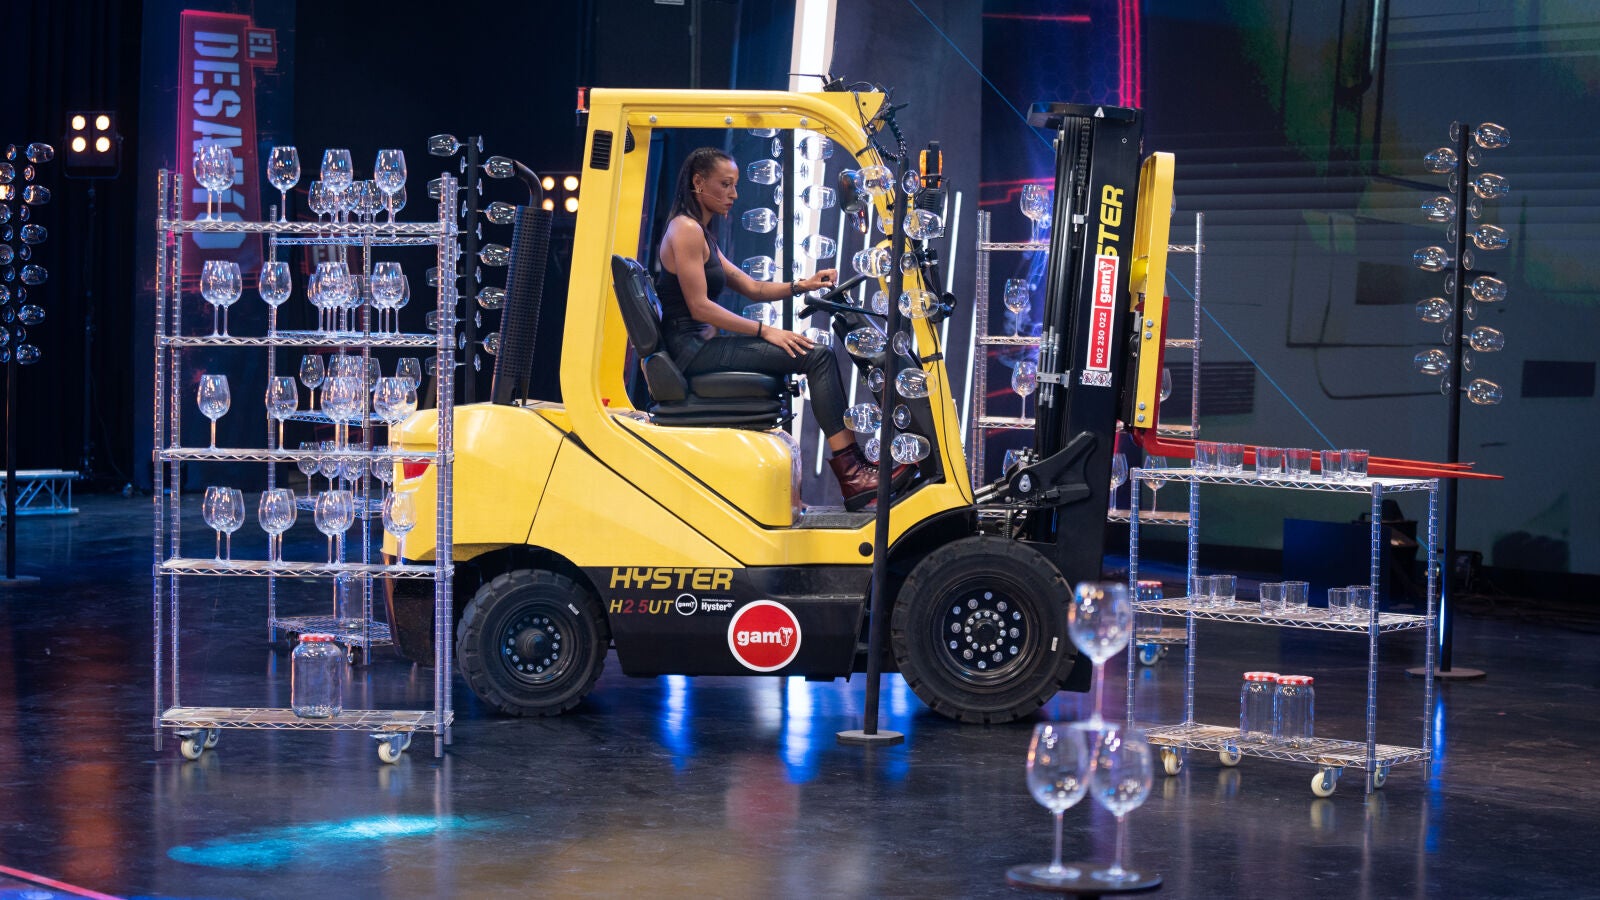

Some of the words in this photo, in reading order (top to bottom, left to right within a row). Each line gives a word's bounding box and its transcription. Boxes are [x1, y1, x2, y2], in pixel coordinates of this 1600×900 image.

[249, 32, 273, 59] EL
[1099, 312, 1107, 328] 022
[609, 567, 734, 591] HYSTER
